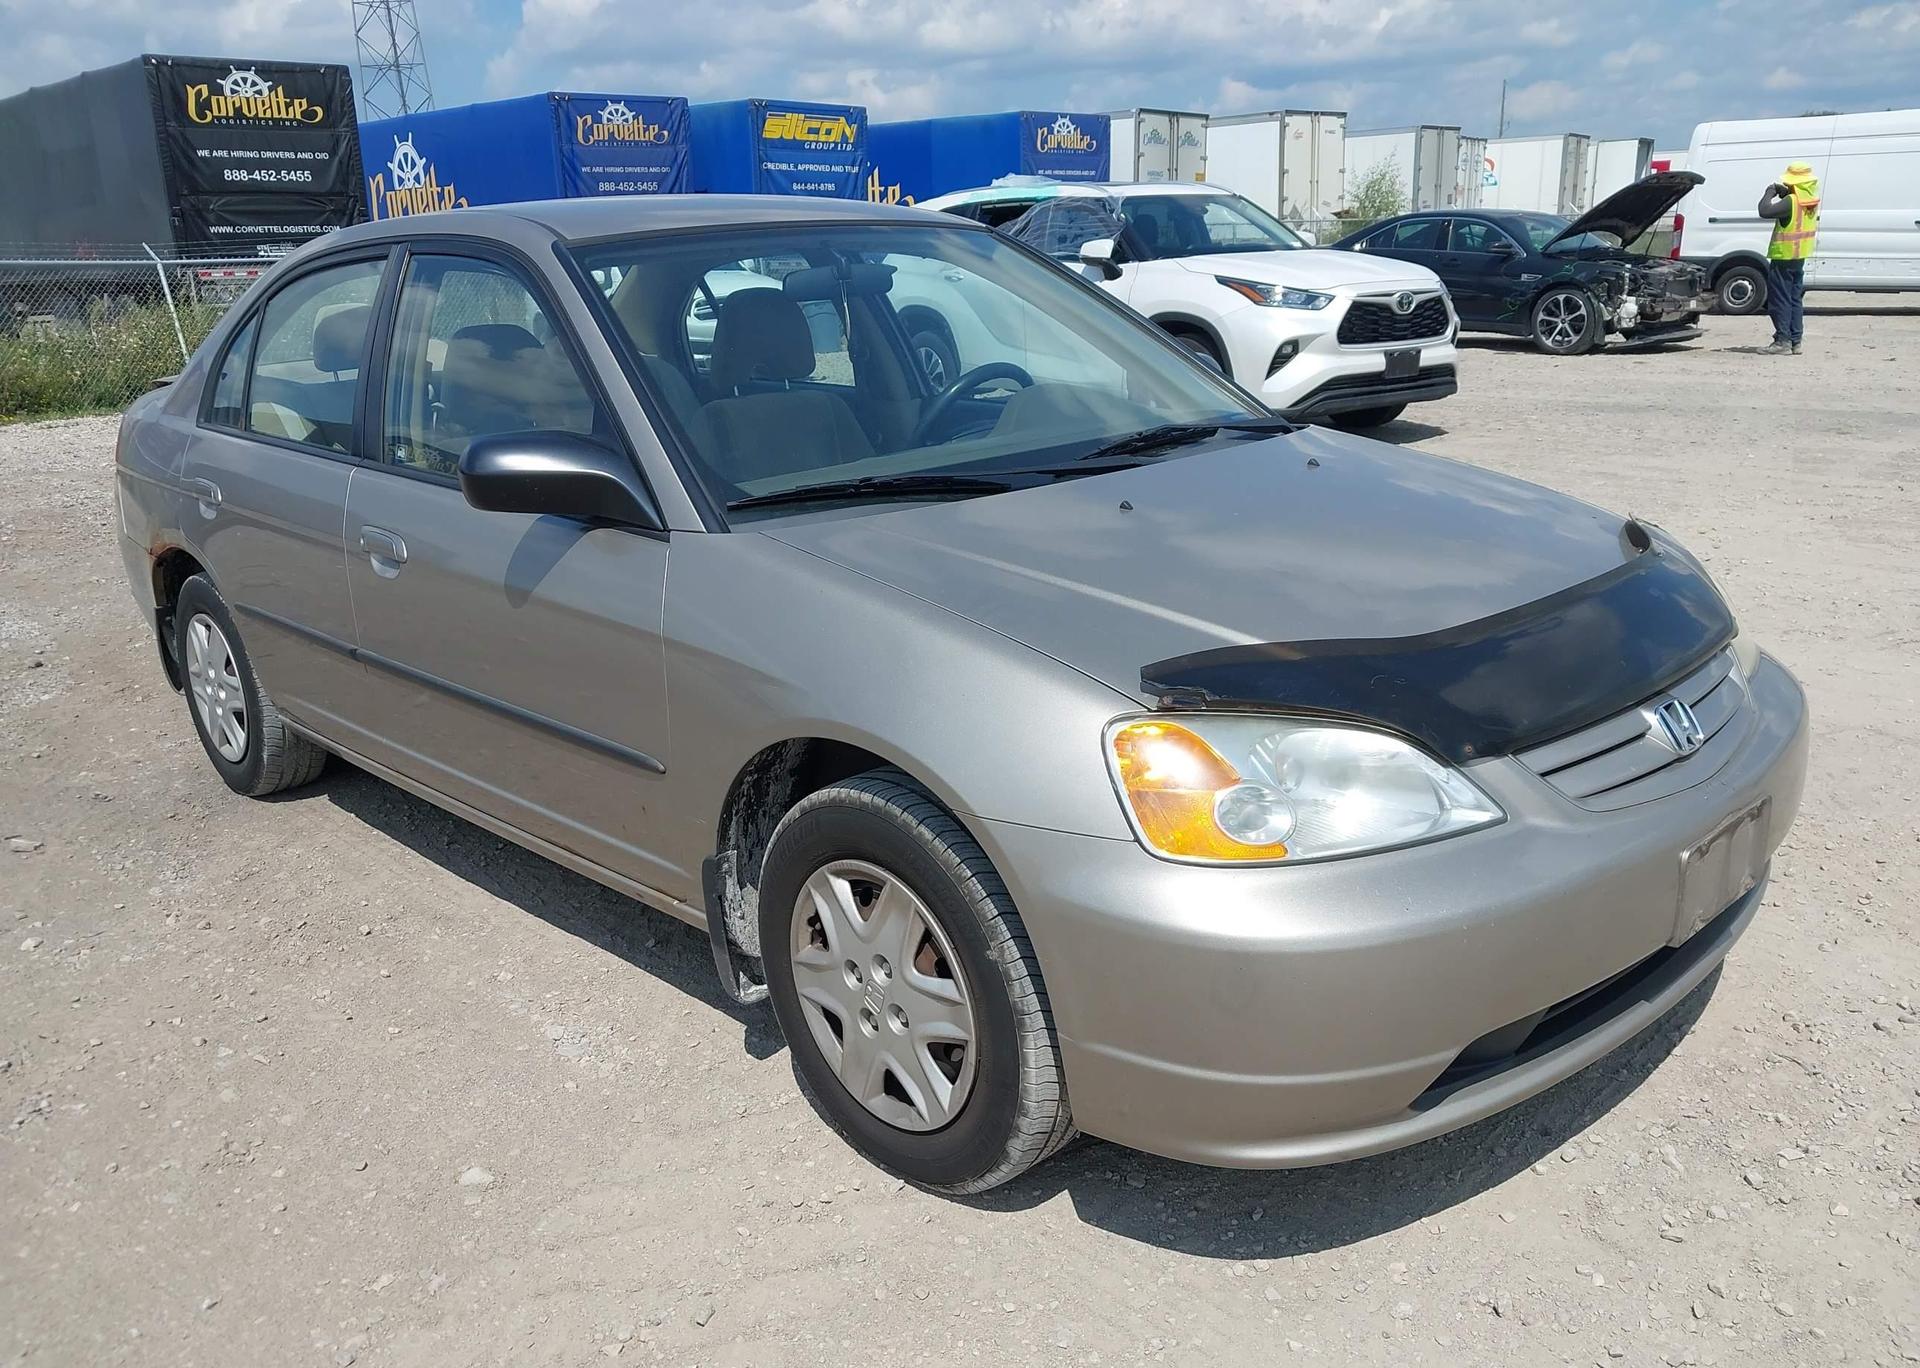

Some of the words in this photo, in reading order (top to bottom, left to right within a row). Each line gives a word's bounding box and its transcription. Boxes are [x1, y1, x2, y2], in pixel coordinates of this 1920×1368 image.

[185, 83, 323, 123] Corvette
[214, 118, 273, 126] LOGISTICS
[576, 114, 669, 146] Corvette
[1036, 126, 1097, 153] Corvette
[804, 141, 835, 150] GROUP
[837, 143, 856, 151] LTD.
[196, 149, 211, 157] WE
[212, 149, 230, 157] ARE
[230, 150, 260, 158] HIRING
[261, 151, 296, 159] DRIVERS
[297, 151, 314, 159] AND
[797, 163, 831, 172] APPROVED
[830, 164, 844, 173] AND
[223, 168, 313, 182] 888-452-5455
[598, 181, 659, 191] 888-452-5455
